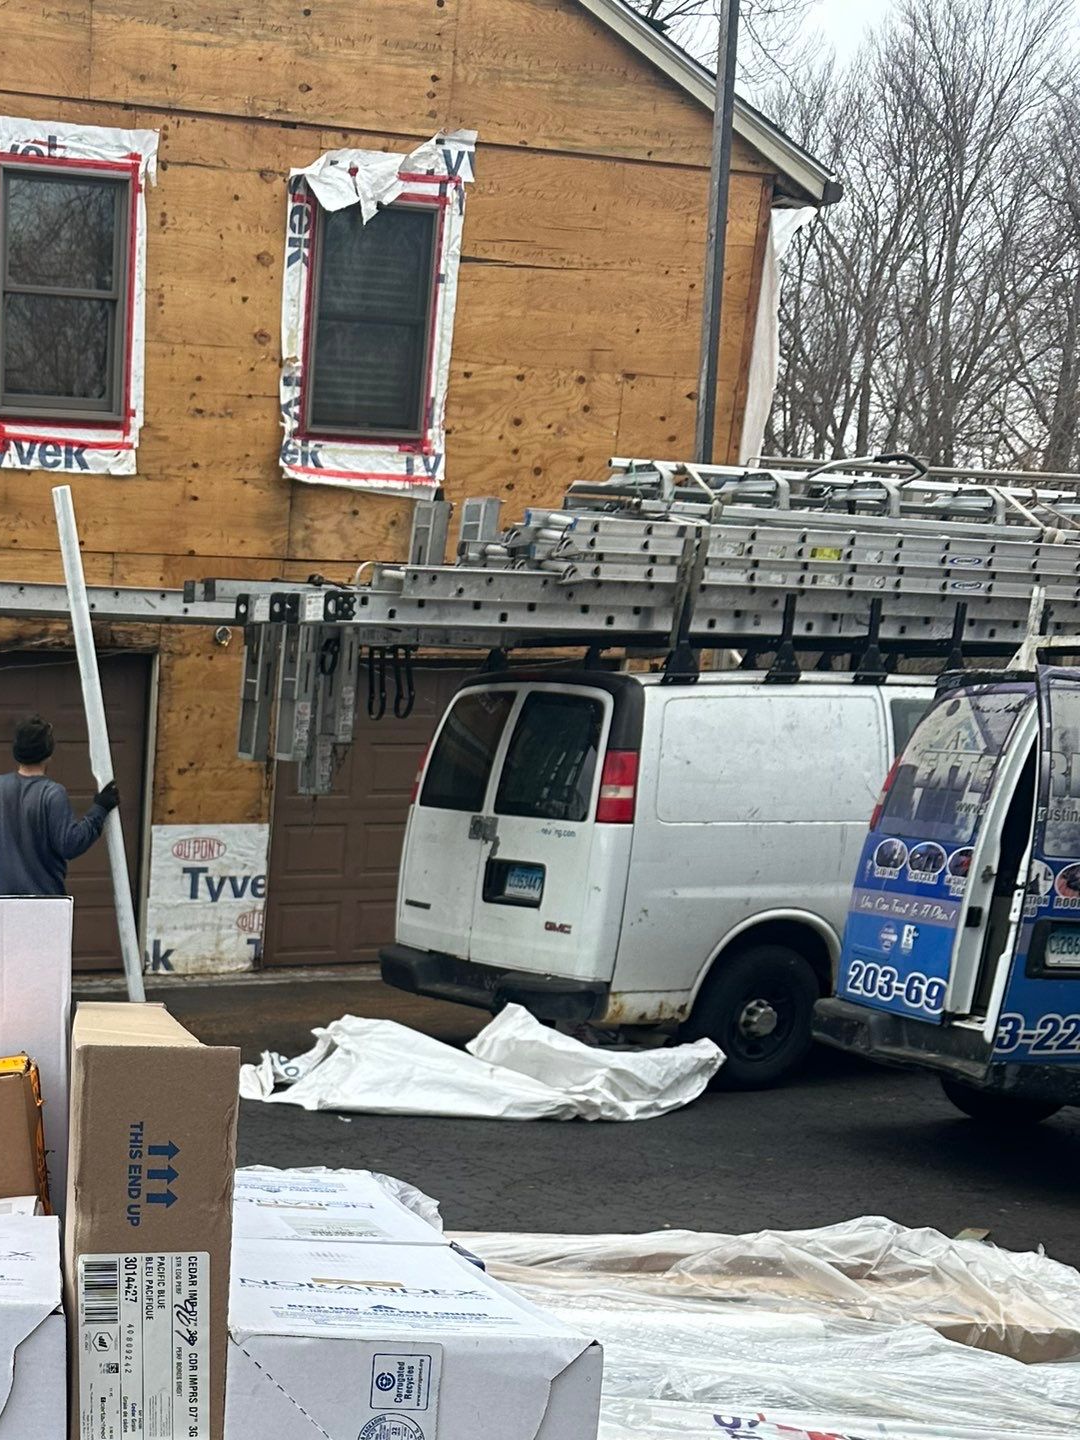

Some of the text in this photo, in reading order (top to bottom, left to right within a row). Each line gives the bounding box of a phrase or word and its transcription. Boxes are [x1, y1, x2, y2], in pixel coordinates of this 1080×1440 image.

[182, 867, 266, 902] Tyve
[545, 921, 572, 934] GMC
[847, 960, 948, 1014] 203-69
[126, 1121, 144, 1227] THIS END UP
[124, 1256, 138, 1304] 3014427
[145, 1256, 154, 1321] BLEU PACIFIQUE
[157, 1256, 166, 1310] PACIFIC BLUE
[188, 1256, 198, 1286] CEDAR
[239, 1277, 487, 1297] NORANDEX
[188, 1352, 198, 1371] CDR
[188, 1374, 199, 1404] IMPRS
[394, 1361, 405, 1403] Corrugated
[404, 1365, 414, 1400] Recycles
[188, 1426, 198, 1438] 3G
